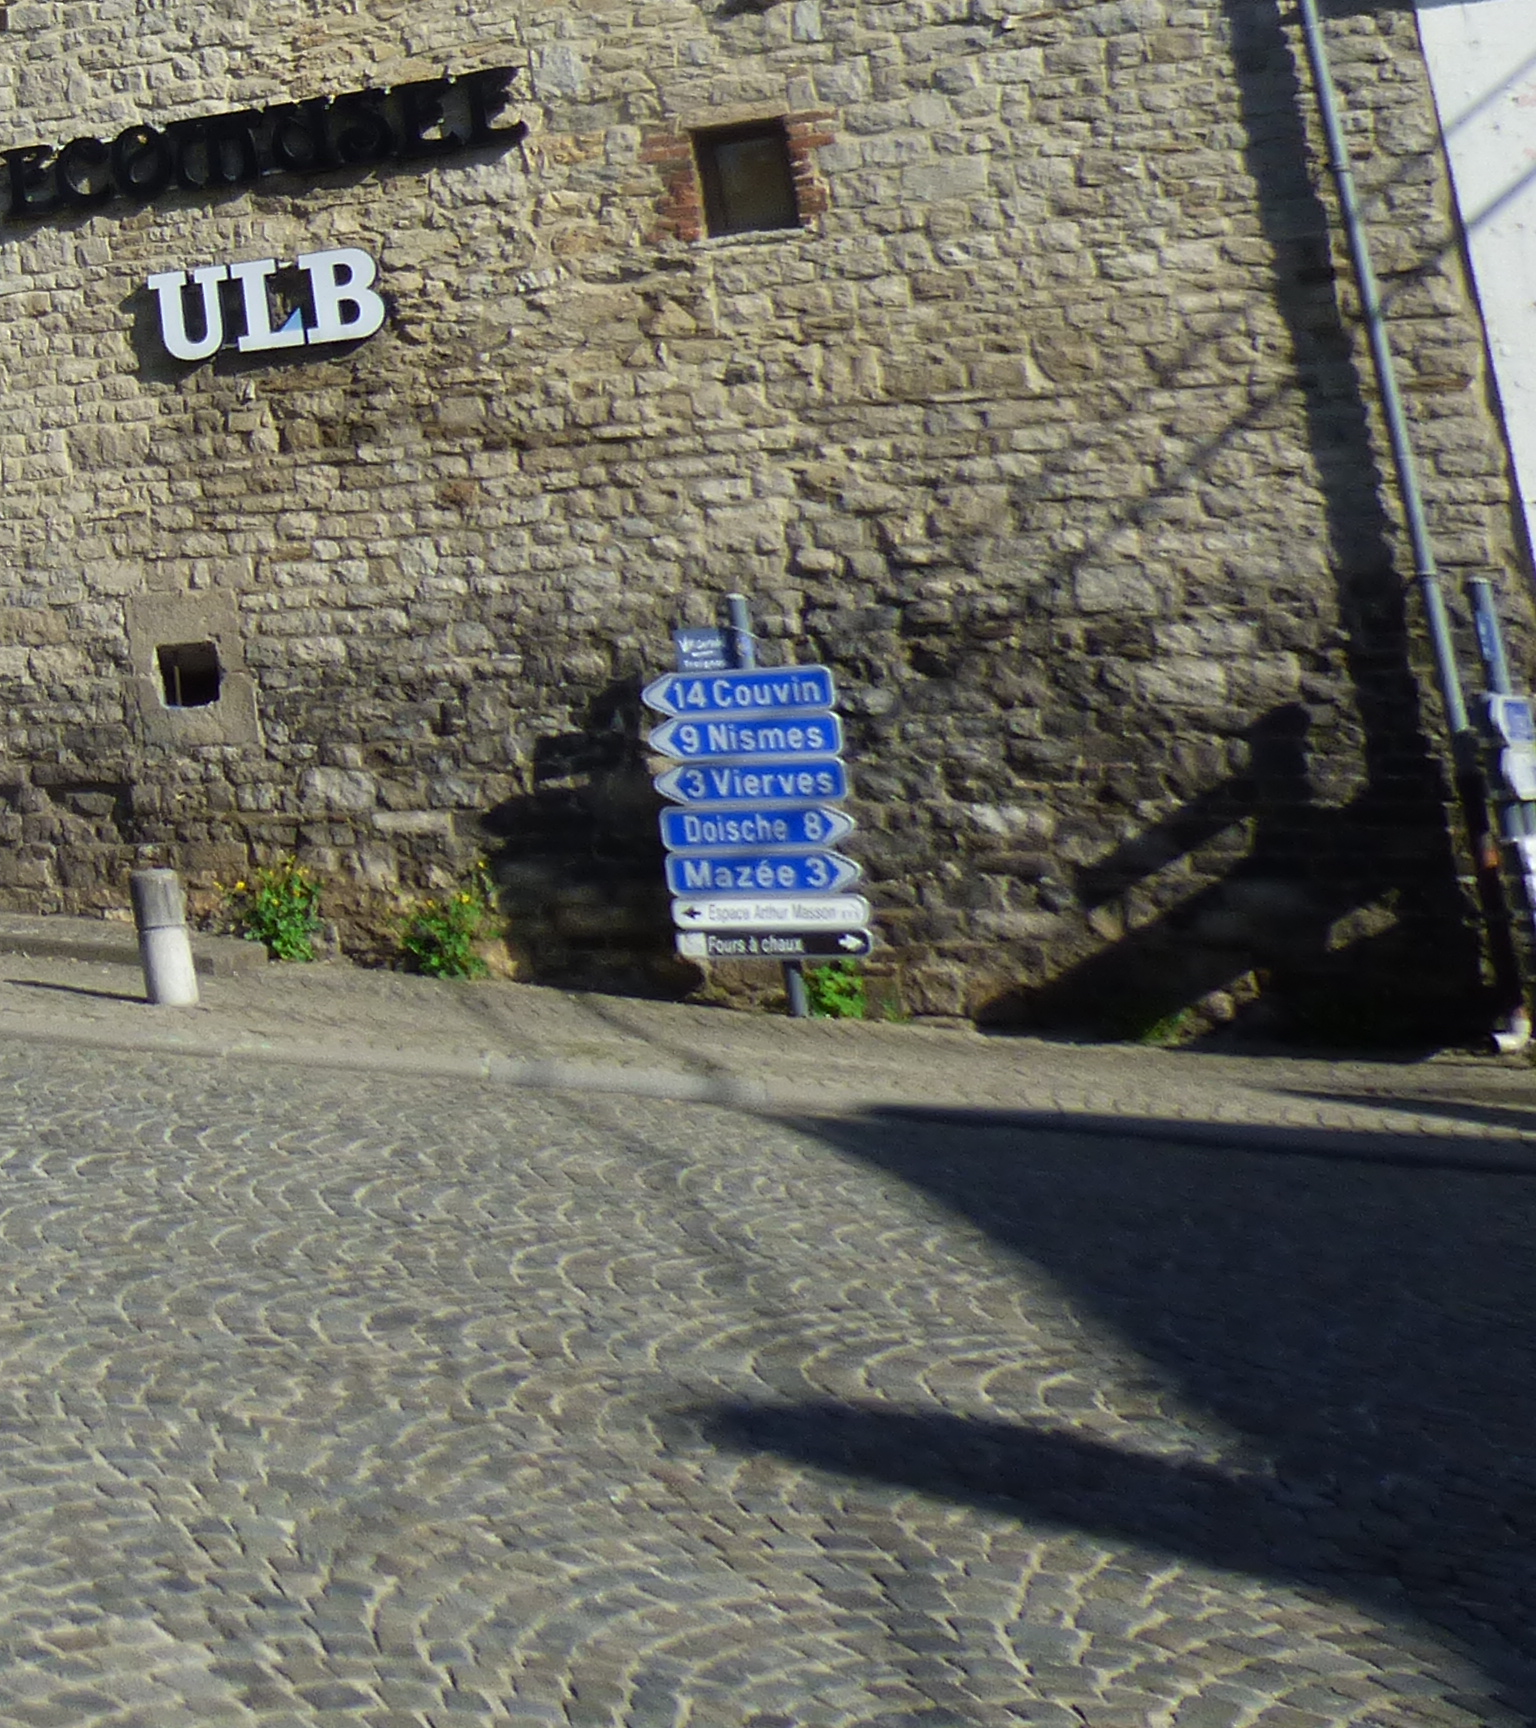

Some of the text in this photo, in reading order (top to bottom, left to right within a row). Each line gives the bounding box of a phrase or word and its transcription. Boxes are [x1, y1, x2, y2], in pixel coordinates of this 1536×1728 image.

[147, 247, 386, 361] ULB
[674, 676, 821, 708] 14 Couvin
[680, 723, 824, 753] 9 Nismes
[685, 767, 834, 798] 3 Vierves
[683, 811, 823, 843] Doische 8
[683, 857, 829, 889] Mazée 3
[708, 902, 837, 923] Espace Arthur Masson
[708, 934, 805, 954] Fours à chaux
